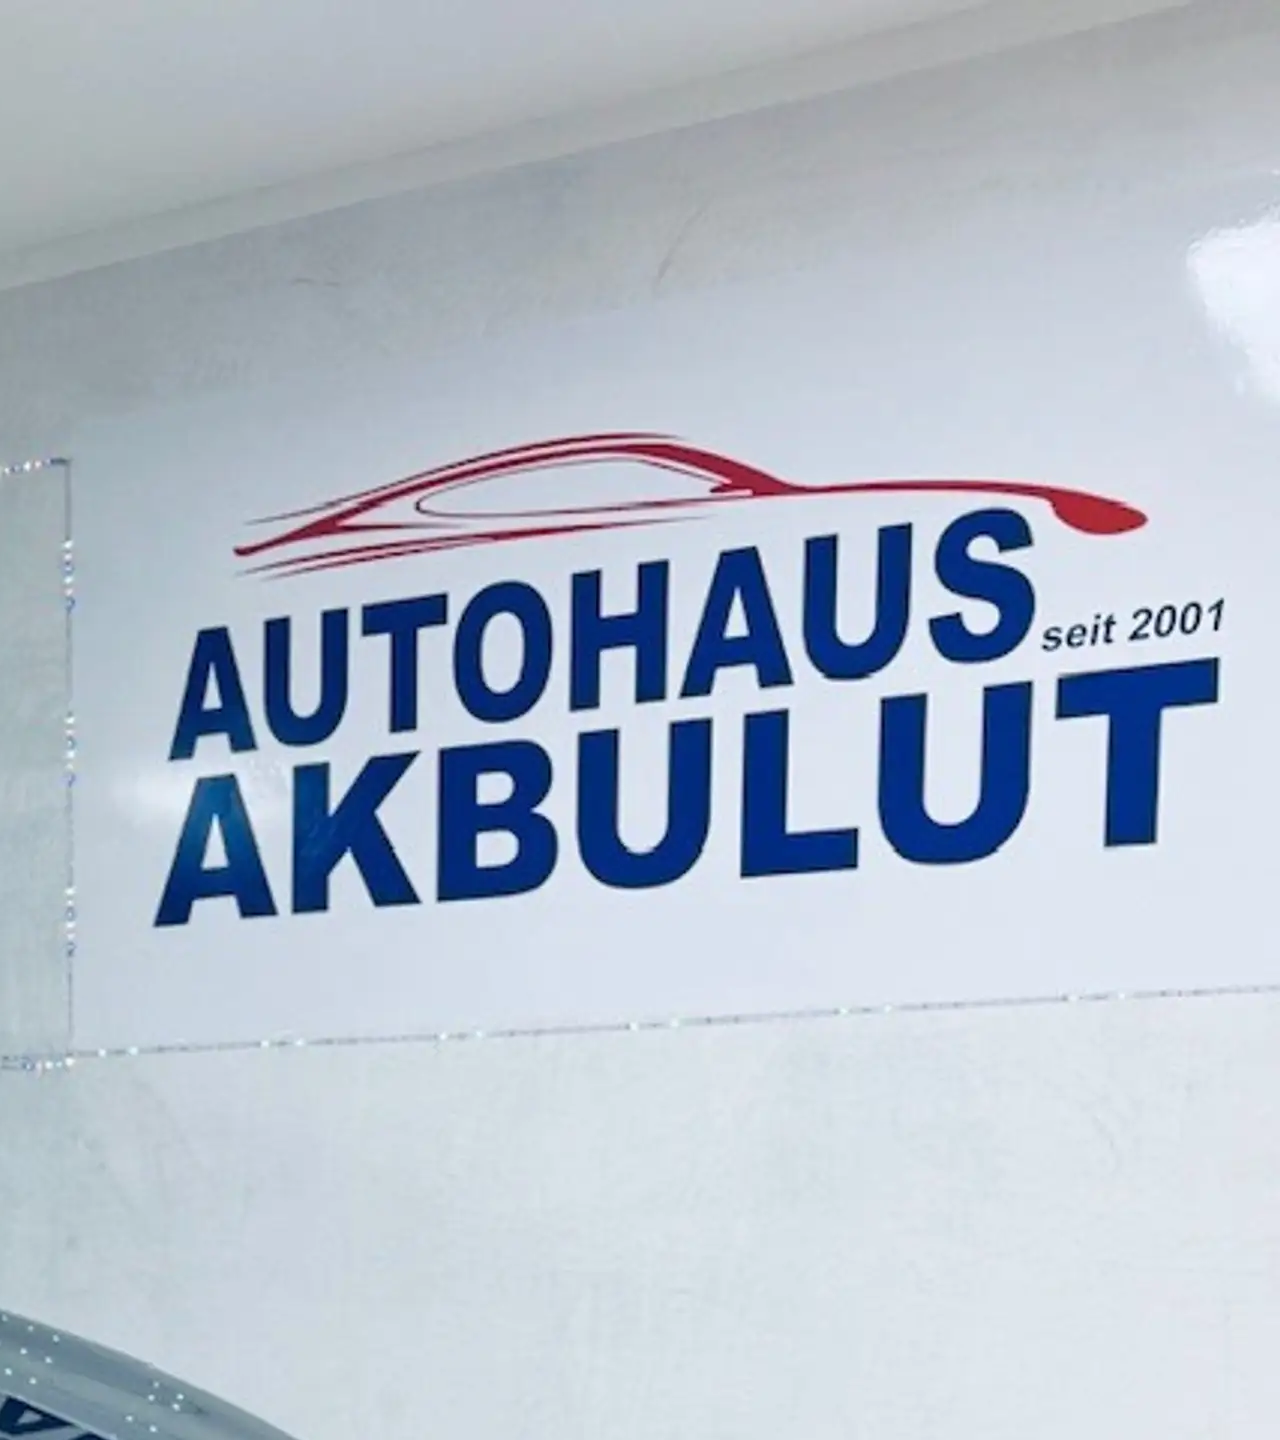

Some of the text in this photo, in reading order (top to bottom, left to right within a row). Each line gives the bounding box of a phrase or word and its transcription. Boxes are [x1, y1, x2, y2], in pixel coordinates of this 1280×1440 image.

[169, 508, 1036, 761] AUTOHAUS
[1042, 597, 1225, 652] seit 2001
[153, 656, 1220, 927] AKBULUT
